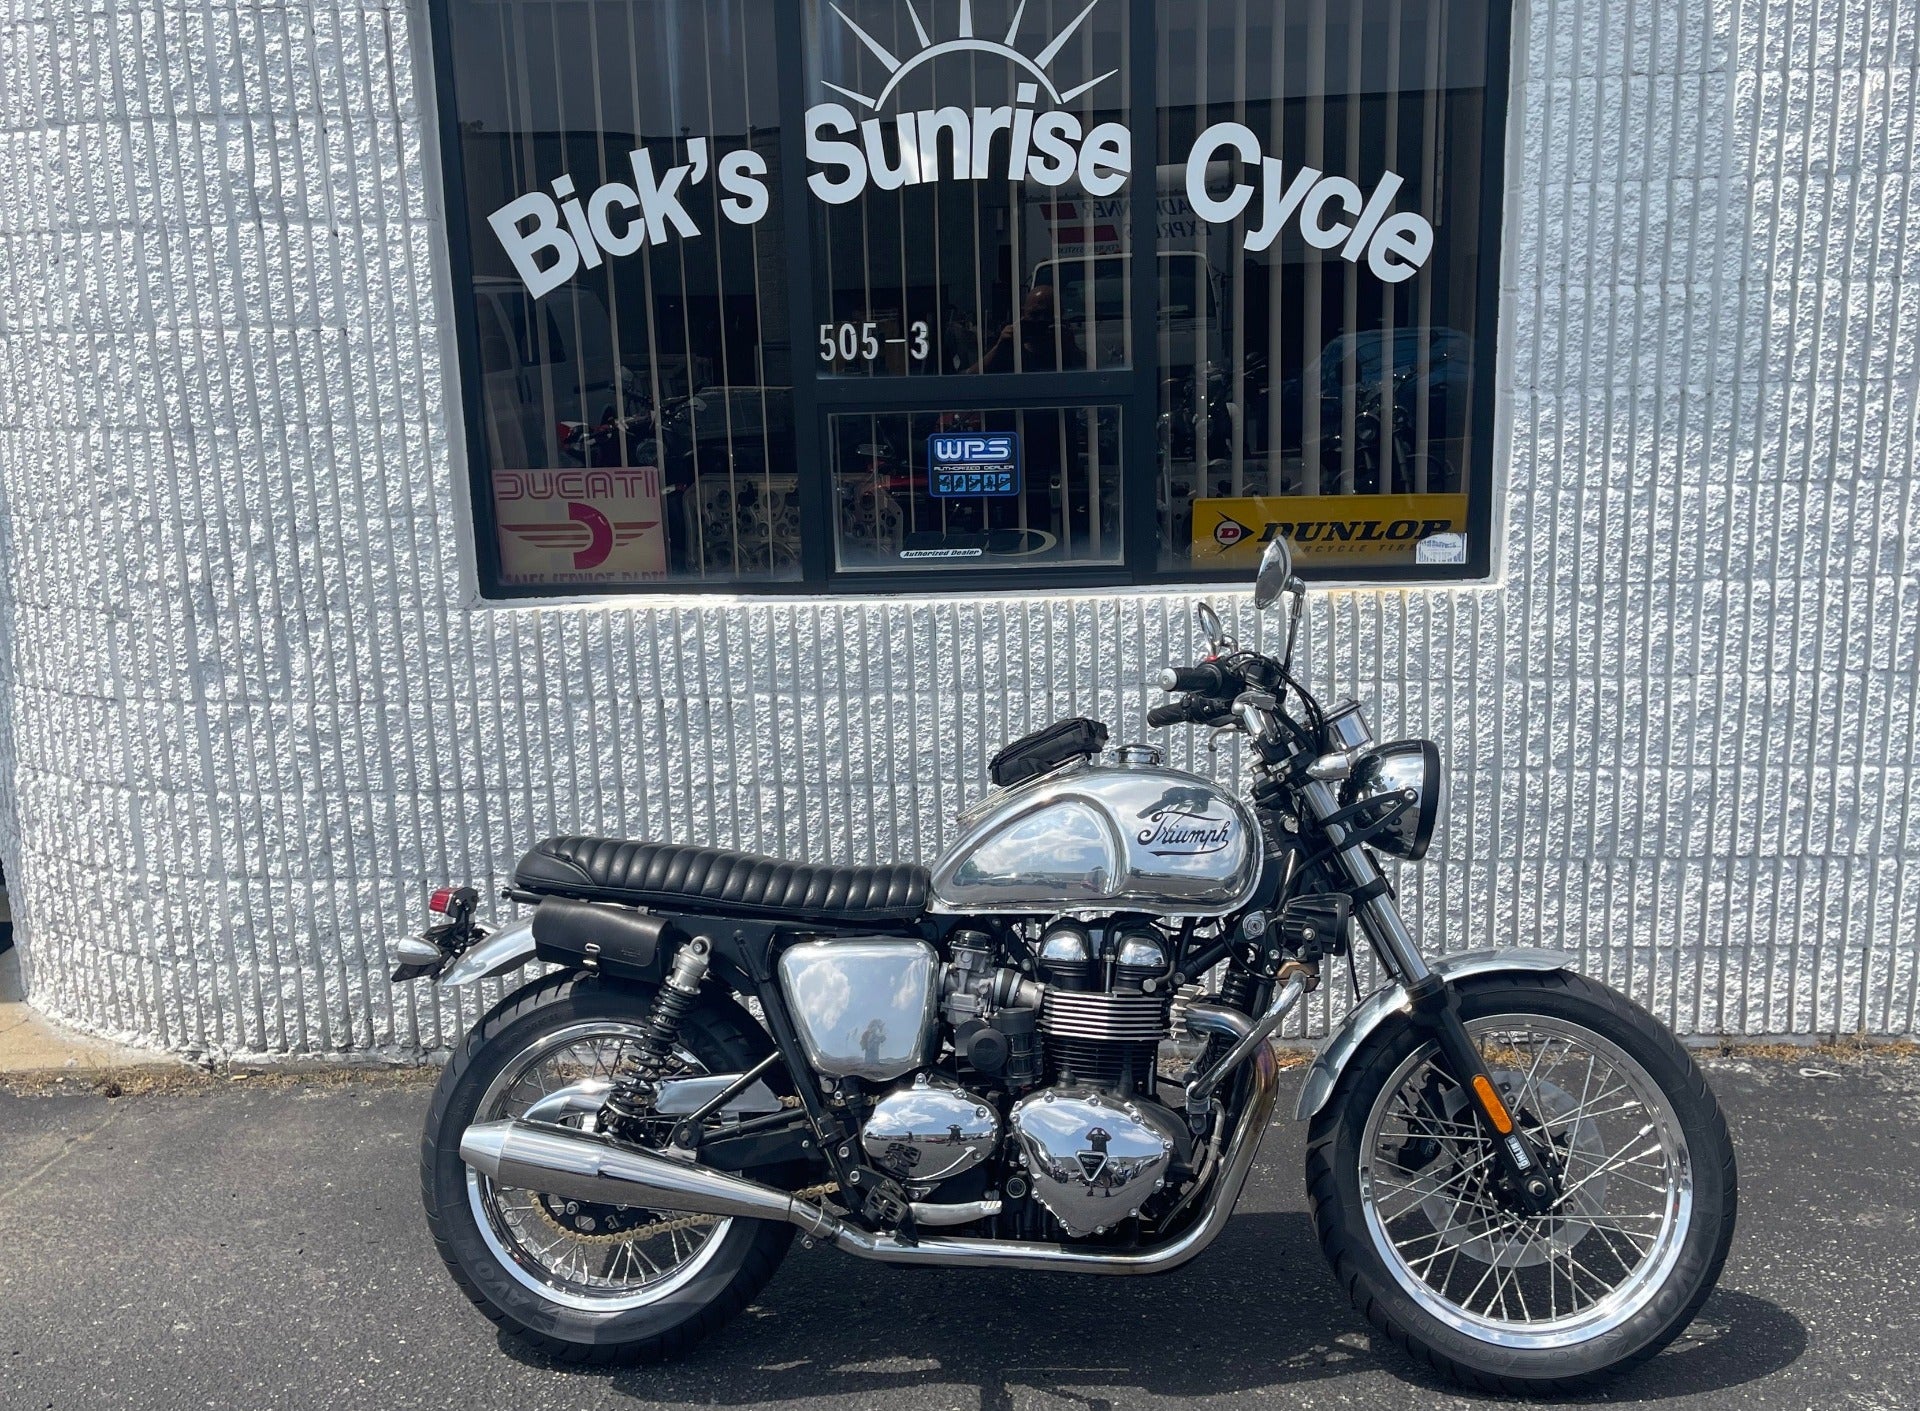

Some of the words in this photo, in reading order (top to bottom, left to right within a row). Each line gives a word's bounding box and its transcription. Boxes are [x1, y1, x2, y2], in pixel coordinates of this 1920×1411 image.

[487, 137, 769, 299] Bick's
[805, 82, 1131, 205] Sunrise
[1185, 121, 1434, 284] Cycle
[934, 438, 1011, 461] WPS
[495, 470, 656, 500] DUCATI
[1257, 519, 1453, 543] DUNLOP
[1137, 808, 1231, 857] Triumph
